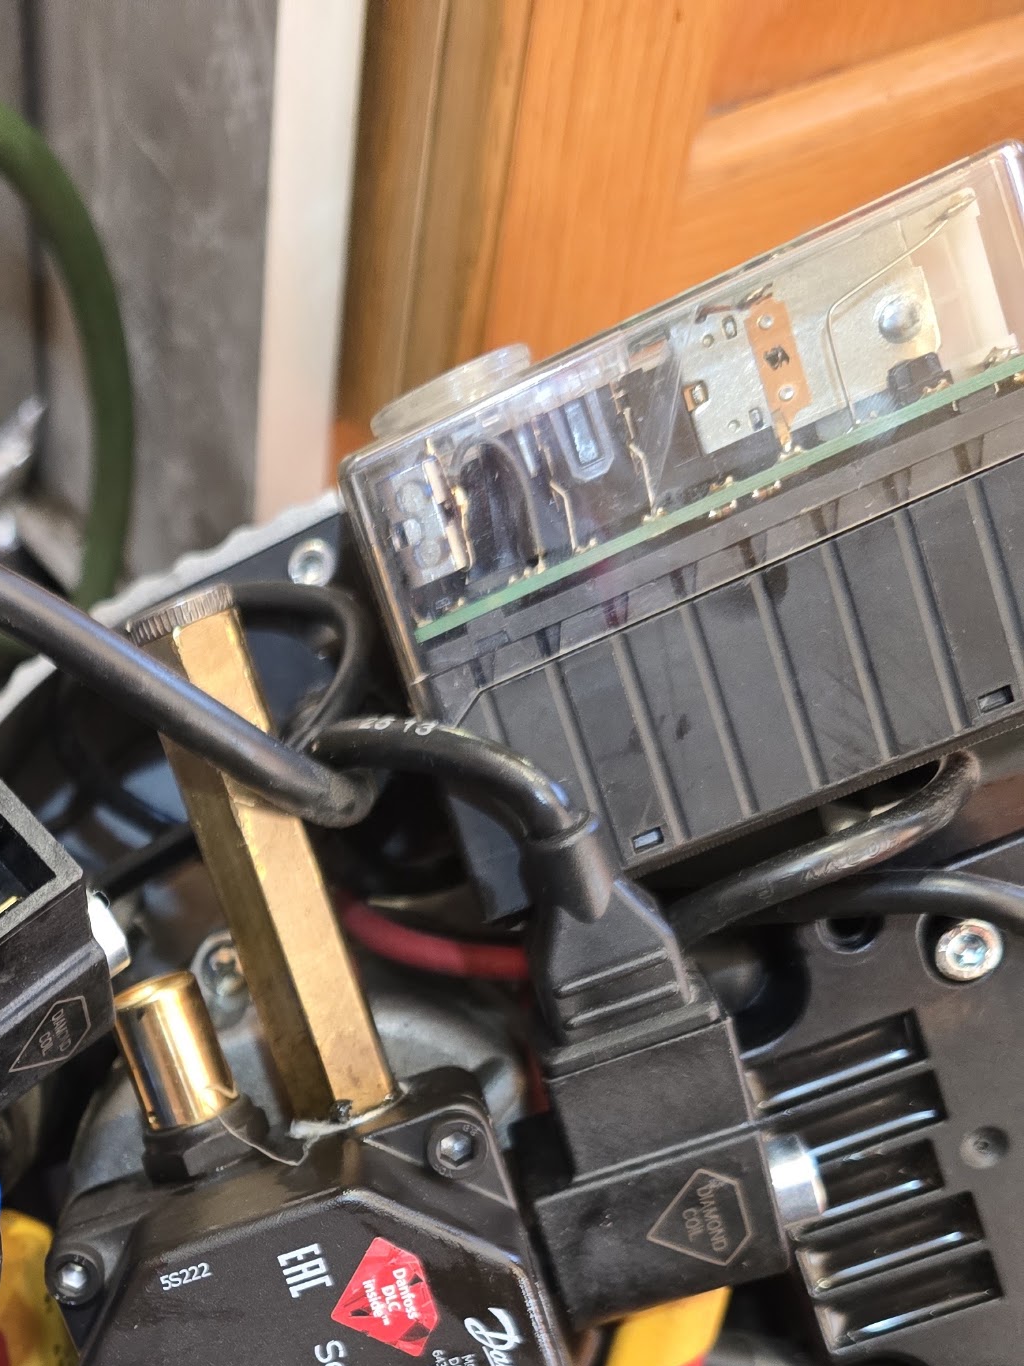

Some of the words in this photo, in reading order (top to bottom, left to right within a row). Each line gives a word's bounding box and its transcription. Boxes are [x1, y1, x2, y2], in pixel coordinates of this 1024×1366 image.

[682, 1207, 704, 1243] COIL
[697, 1186, 728, 1252] DIAMOND
[381, 1284, 401, 1312] DLC
[392, 1267, 419, 1319] Danfoss
